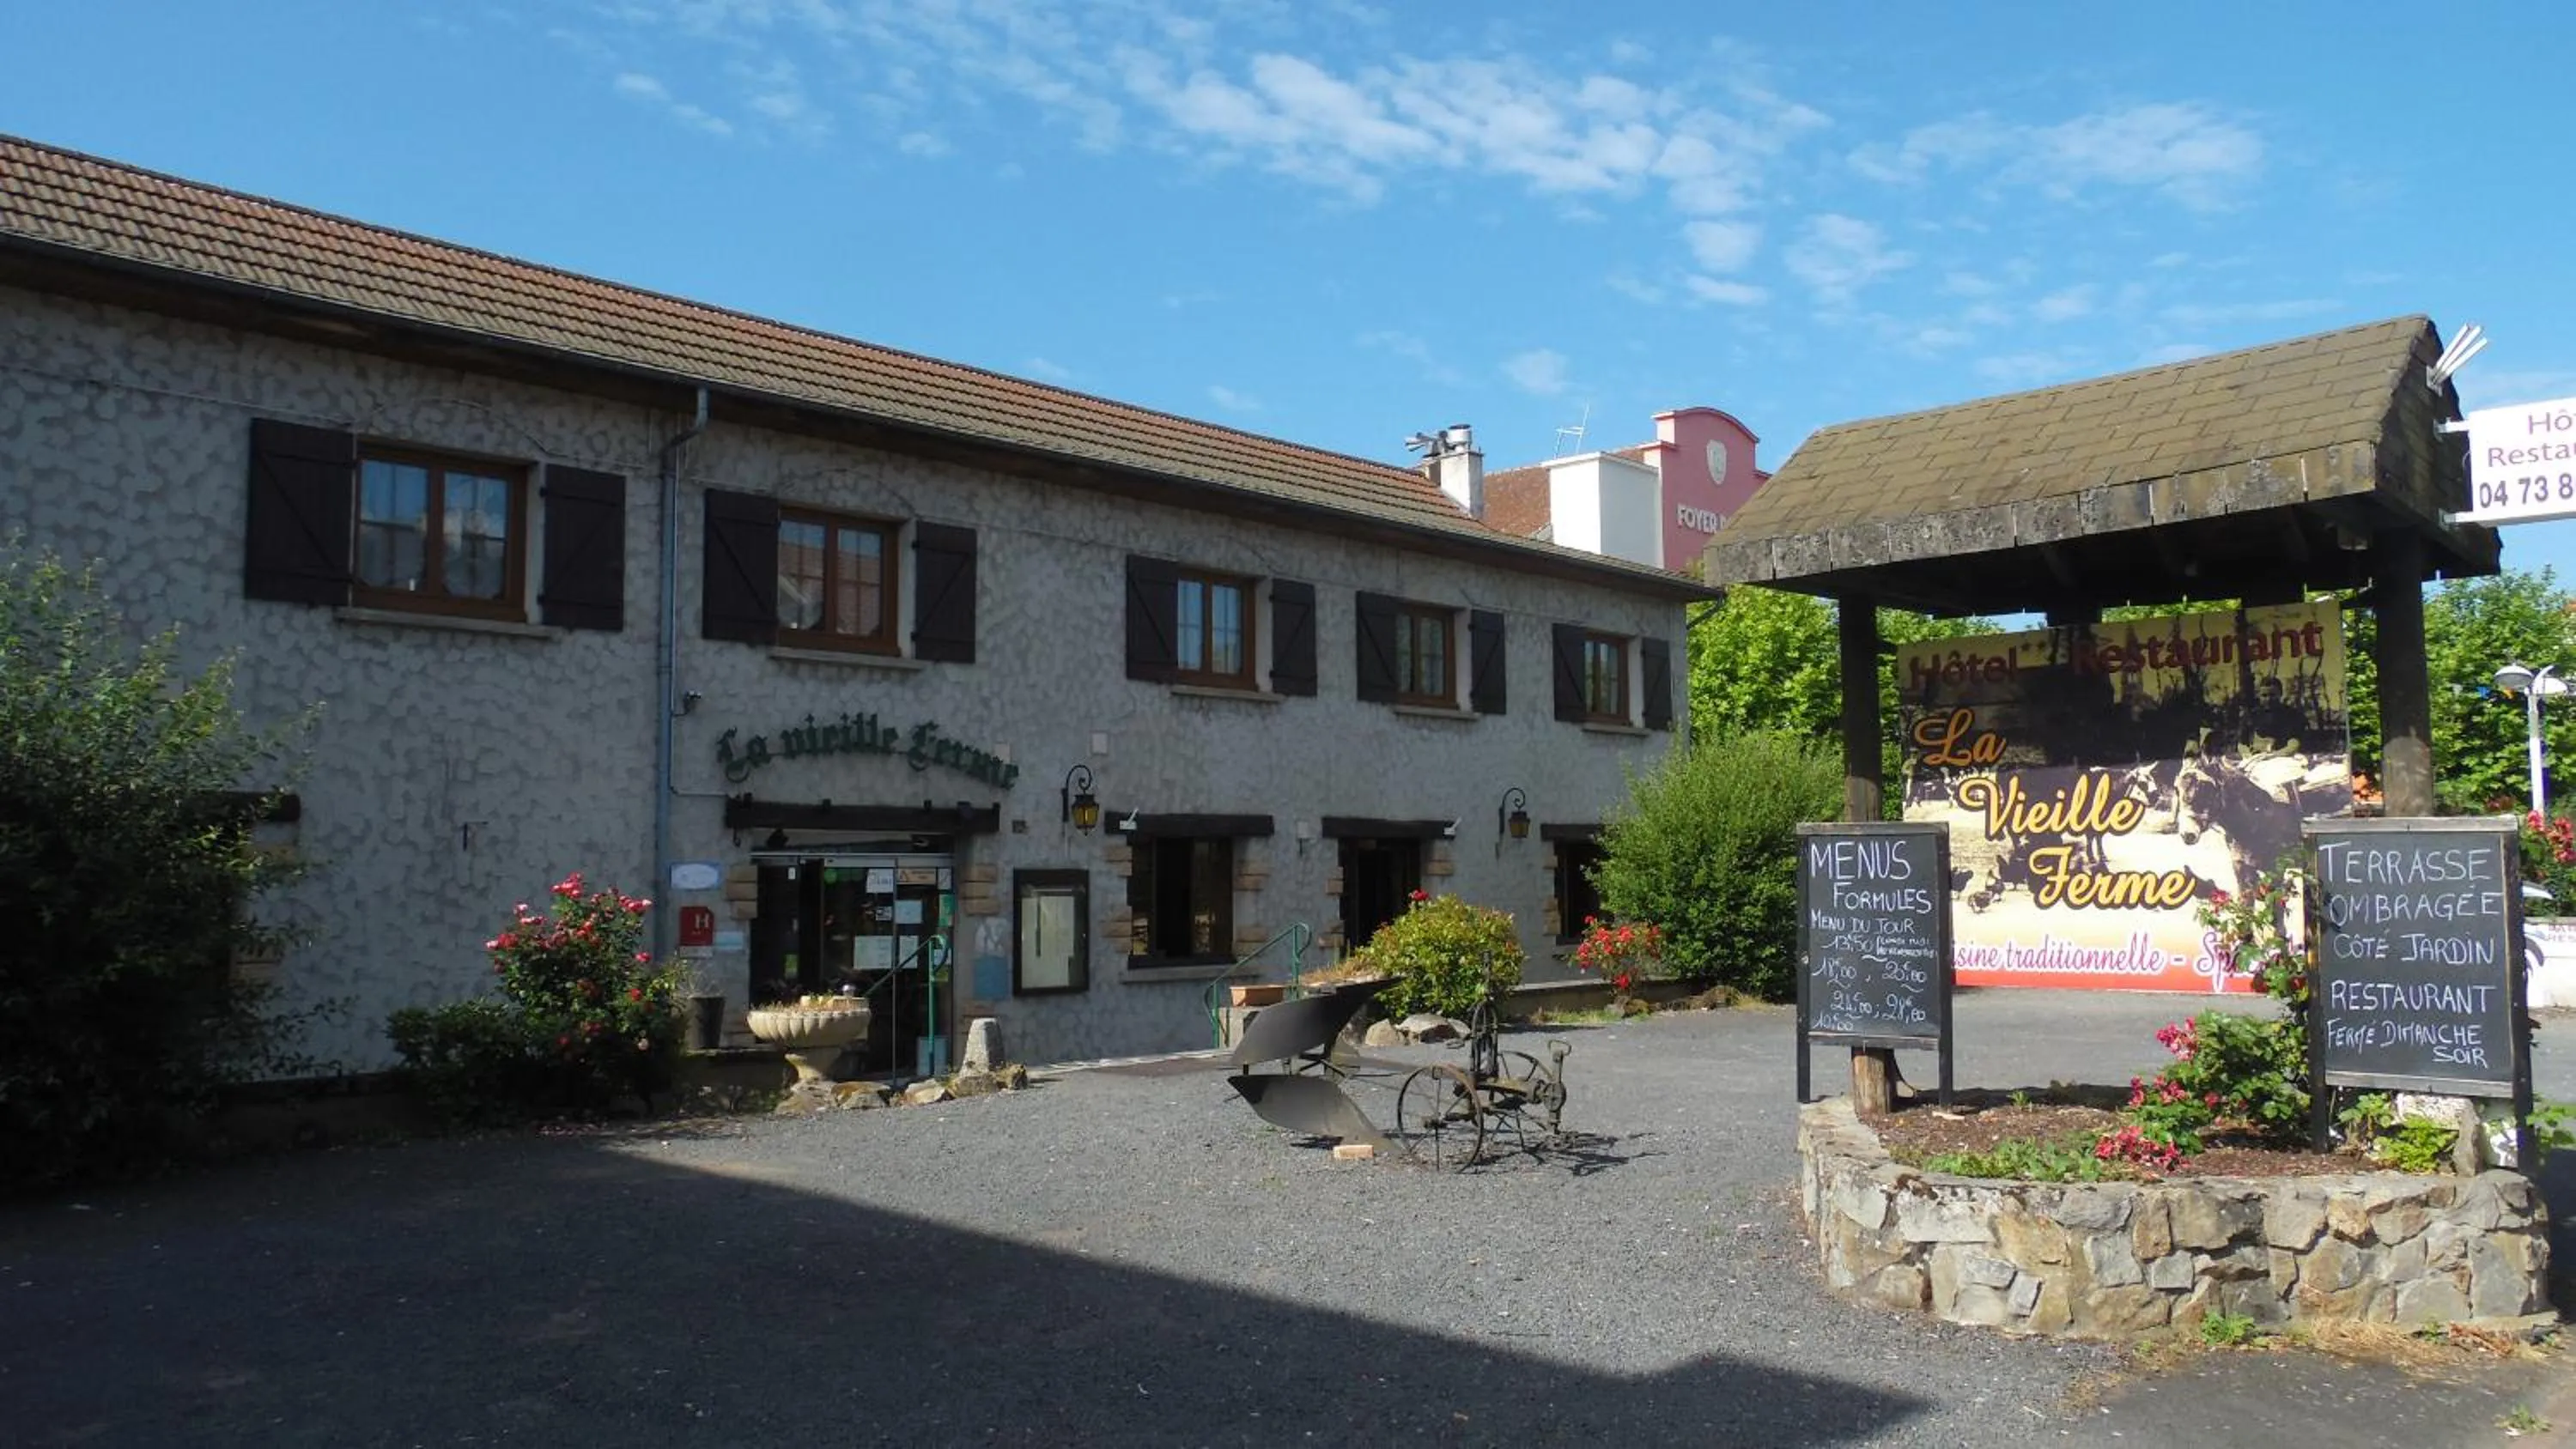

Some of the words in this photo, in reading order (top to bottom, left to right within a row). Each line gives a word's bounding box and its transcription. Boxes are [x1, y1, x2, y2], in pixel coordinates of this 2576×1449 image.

[2528, 408, 2576, 434] Hô
[2479, 480, 2508, 508] 04
[2518, 475, 2549, 505] 73
[2558, 472, 2576, 500] 8
[1677, 503, 1717, 534] FOYER
[1909, 646, 2018, 691] Hôtel
[2069, 619, 2324, 676] Restaurant
[1914, 708, 2006, 766] La
[1958, 774, 2145, 840] Vieille
[1811, 840, 1911, 881] MENUS
[2028, 846, 2196, 908] Ferme
[2319, 840, 2492, 885] TERRASSE
[1833, 882, 1932, 914] FORMULES
[1811, 910, 1845, 931] MENU
[1851, 918, 1870, 933] DU
[1951, 939, 2002, 967] isine
[2005, 932, 2164, 972] traditionnelle
[2331, 979, 2495, 1014] RESTAURANT
